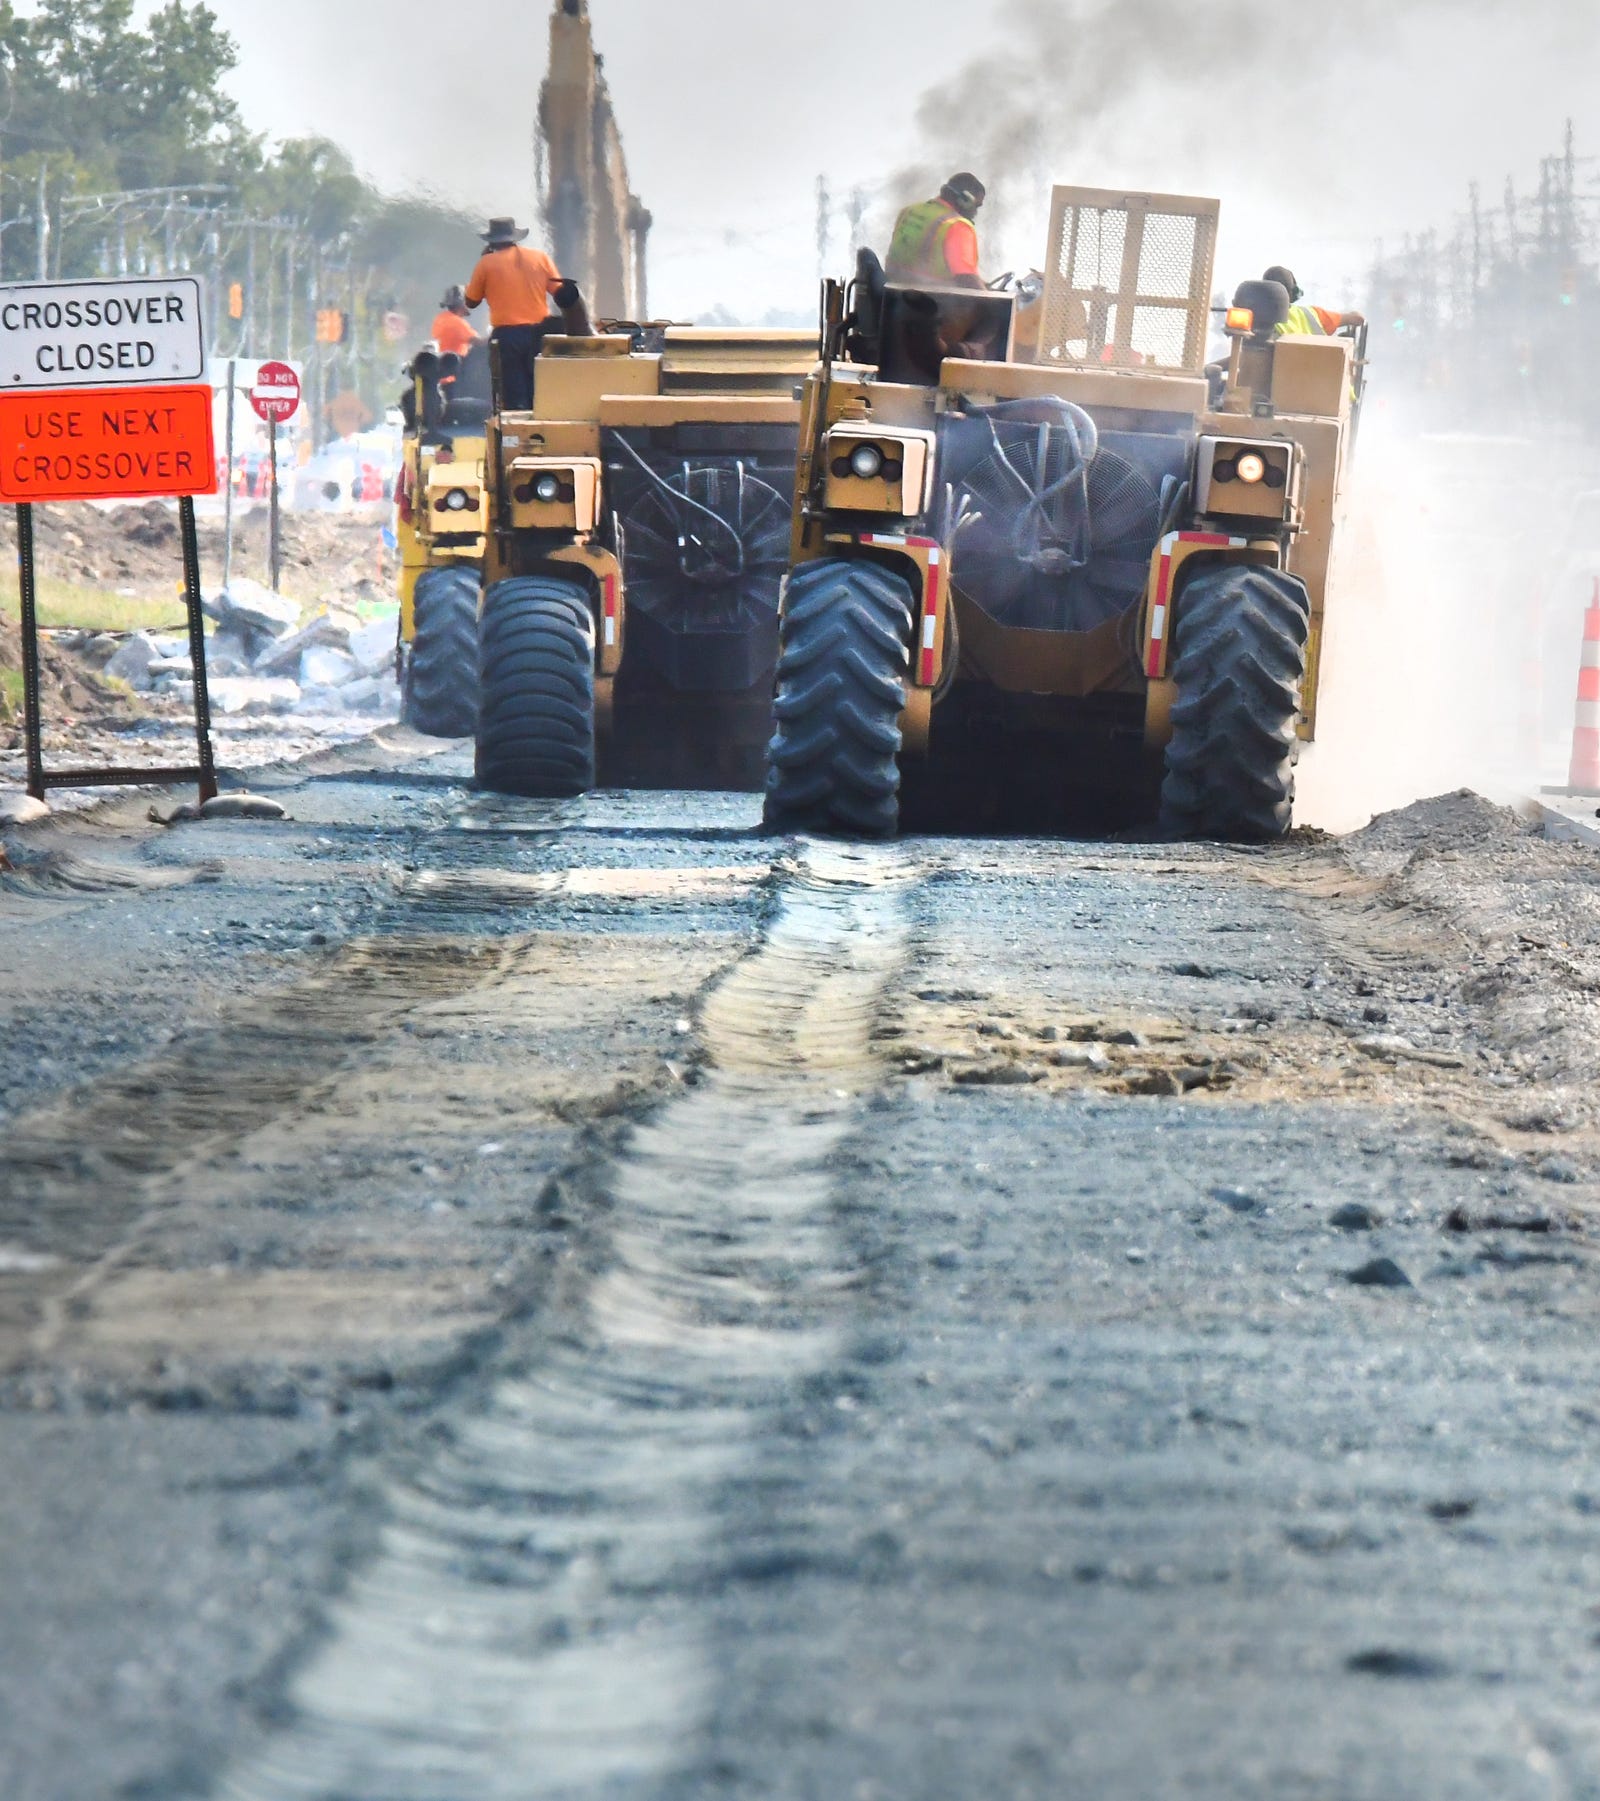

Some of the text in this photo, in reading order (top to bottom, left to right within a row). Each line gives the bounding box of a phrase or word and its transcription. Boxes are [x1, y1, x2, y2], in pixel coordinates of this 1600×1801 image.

[2, 297, 184, 330] CROSSOVER
[36, 341, 155, 372] CLOSED
[275, 374, 293, 383] NOT
[260, 401, 290, 412] ENTER
[24, 408, 176, 439] USE NEXT
[13, 451, 193, 482] CROSSOVER
